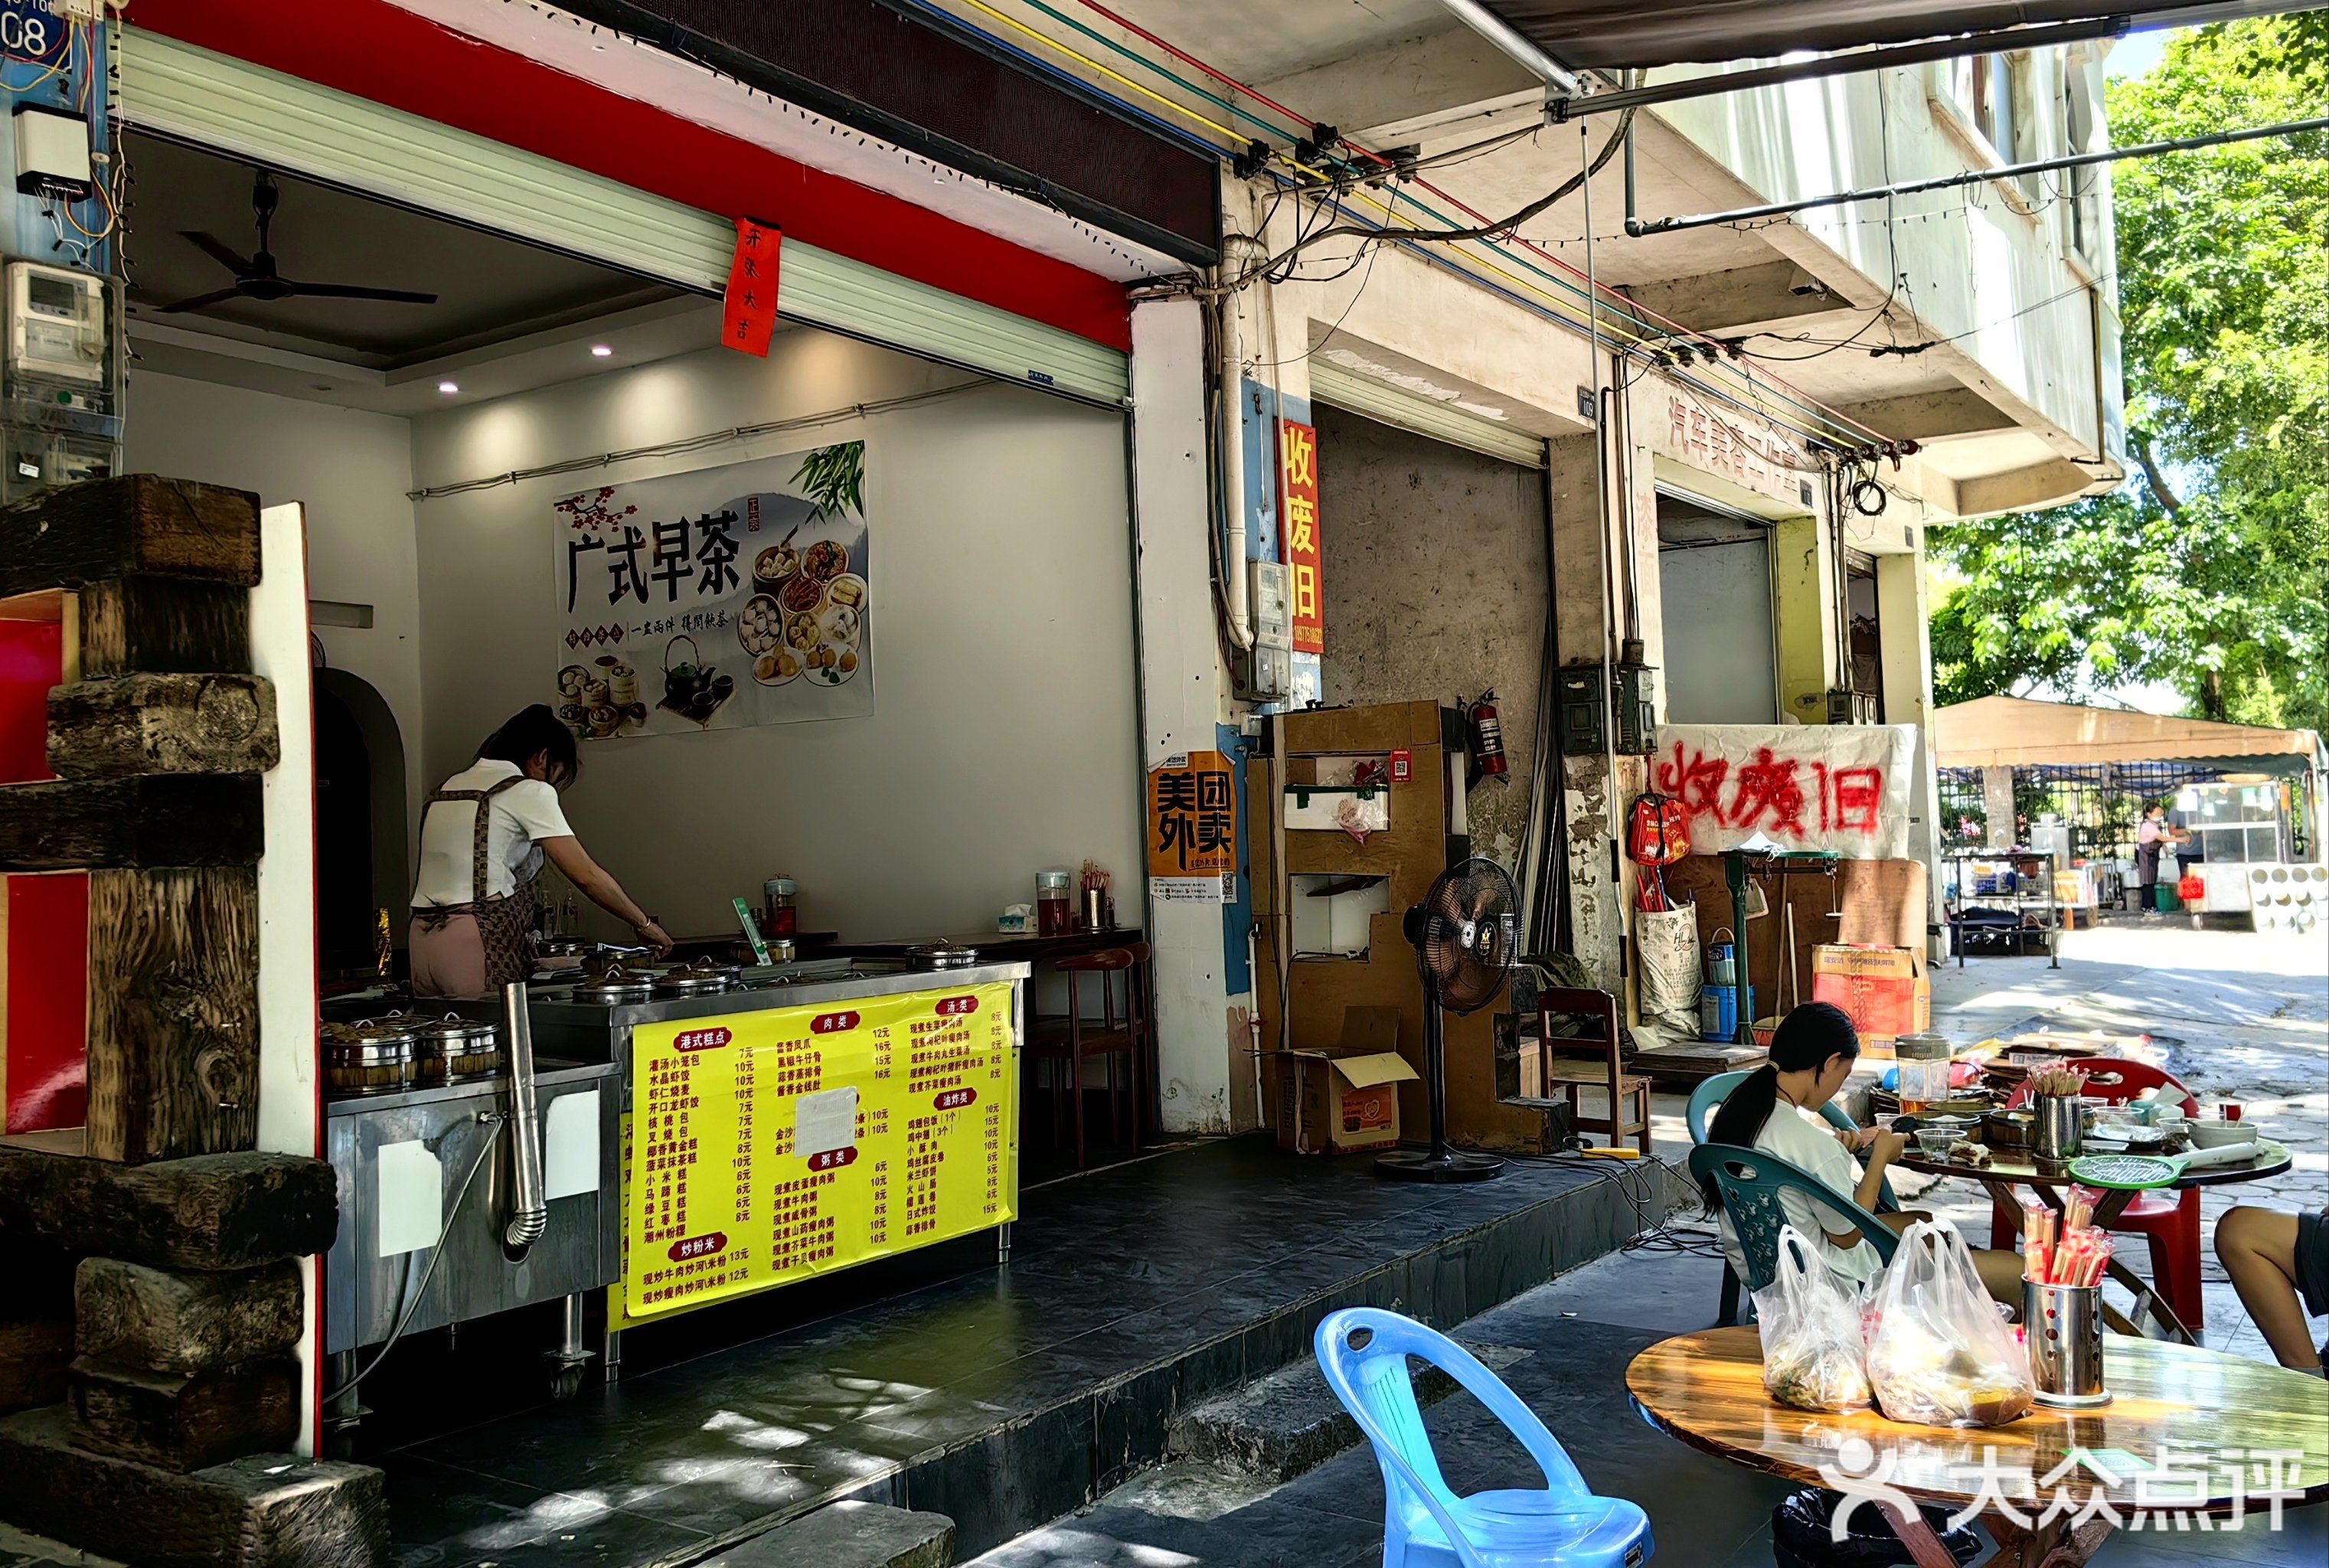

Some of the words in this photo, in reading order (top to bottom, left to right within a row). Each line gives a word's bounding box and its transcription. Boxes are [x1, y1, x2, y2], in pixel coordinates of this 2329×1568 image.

[1668, 395, 1798, 493] 汽车美容工作室
[1283, 426, 1315, 619] 收废旧
[568, 510, 741, 614] 广式早茶
[1157, 771, 1232, 813] 美团
[1158, 812, 1232, 872] 外卖
[946, 998, 969, 1014] 汤类
[991, 1011, 1003, 1023] 8元
[823, 1014, 848, 1031] 肉类
[872, 1027, 890, 1039] 12元
[991, 1025, 1003, 1037] 8元
[680, 1030, 725, 1049] 港式糕点
[648, 1054, 700, 1072] 灌汤小笼包
[739, 1046, 753, 1059] 7元
[777, 1050, 822, 1069] 黑椒牛仔骨
[874, 1040, 892, 1052] 16元
[910, 1045, 971, 1065] 现煮牛肉丸生菜汤
[991, 1054, 1002, 1065] 8元
[648, 1069, 690, 1086] 水晶虾饺
[734, 1060, 754, 1073] 10元
[777, 1065, 822, 1083] 蒜香蒸排骨
[874, 1054, 891, 1067] 15元
[648, 1083, 690, 1100] 虾仁烧麦
[734, 1073, 754, 1086] 10元
[776, 1080, 822, 1098] 酱香金钱肚
[874, 1067, 891, 1080] 16元
[908, 1075, 962, 1095] 现煮芥菜瘦肉汤
[990, 1068, 1001, 1079] 8元
[648, 1096, 700, 1115] 开口龙虾饺
[734, 1087, 754, 1100] 10元
[942, 1091, 969, 1108] 油炸类
[985, 1102, 1000, 1114] 10元
[648, 1112, 689, 1130] 核桃包
[739, 1100, 753, 1113] 7元
[872, 1108, 889, 1121] 10元
[985, 1115, 999, 1126] 15元
[647, 1125, 688, 1144] 叉烧包
[738, 1114, 753, 1127] 7元
[872, 1122, 888, 1135] 10元
[984, 1126, 999, 1138] 10元
[647, 1138, 698, 1158] 椰香黄金糕
[737, 1128, 753, 1141] 7元
[984, 1138, 998, 1152] 10元
[645, 1152, 697, 1173] 菠菜抹茶糕
[737, 1142, 752, 1155] 8元
[821, 1150, 845, 1168] 粥类
[645, 1168, 687, 1187] 小米糕
[732, 1155, 752, 1168] 10元
[773, 1171, 835, 1196] 现煮皮蛋瘦肉粥
[644, 1196, 687, 1217] 绿豆糕
[736, 1183, 751, 1195] 6元
[645, 1181, 687, 1201] 马蹄糕
[773, 1190, 818, 1212] 现煮牛肉粥
[871, 1174, 888, 1187] 10元
[874, 1188, 888, 1201] 8元
[644, 1210, 687, 1230] 红枣糕
[736, 1197, 751, 1209] 6元
[735, 1210, 750, 1223] 8元
[906, 1203, 936, 1220] 日式炸饺
[982, 1203, 998, 1215] 15元
[773, 1216, 835, 1242] 现煮山药瘦肉粥
[874, 1203, 887, 1216] 8元
[681, 1236, 715, 1257] 炒粉米
[772, 1230, 835, 1256] 现煮芥菜牛肉粥
[870, 1217, 887, 1230] 10元
[730, 1247, 750, 1262] 13元
[772, 1245, 835, 1272] 现煮干贝瘦肉粥
[870, 1231, 887, 1245] 10元
[729, 1267, 749, 1282] 12元
